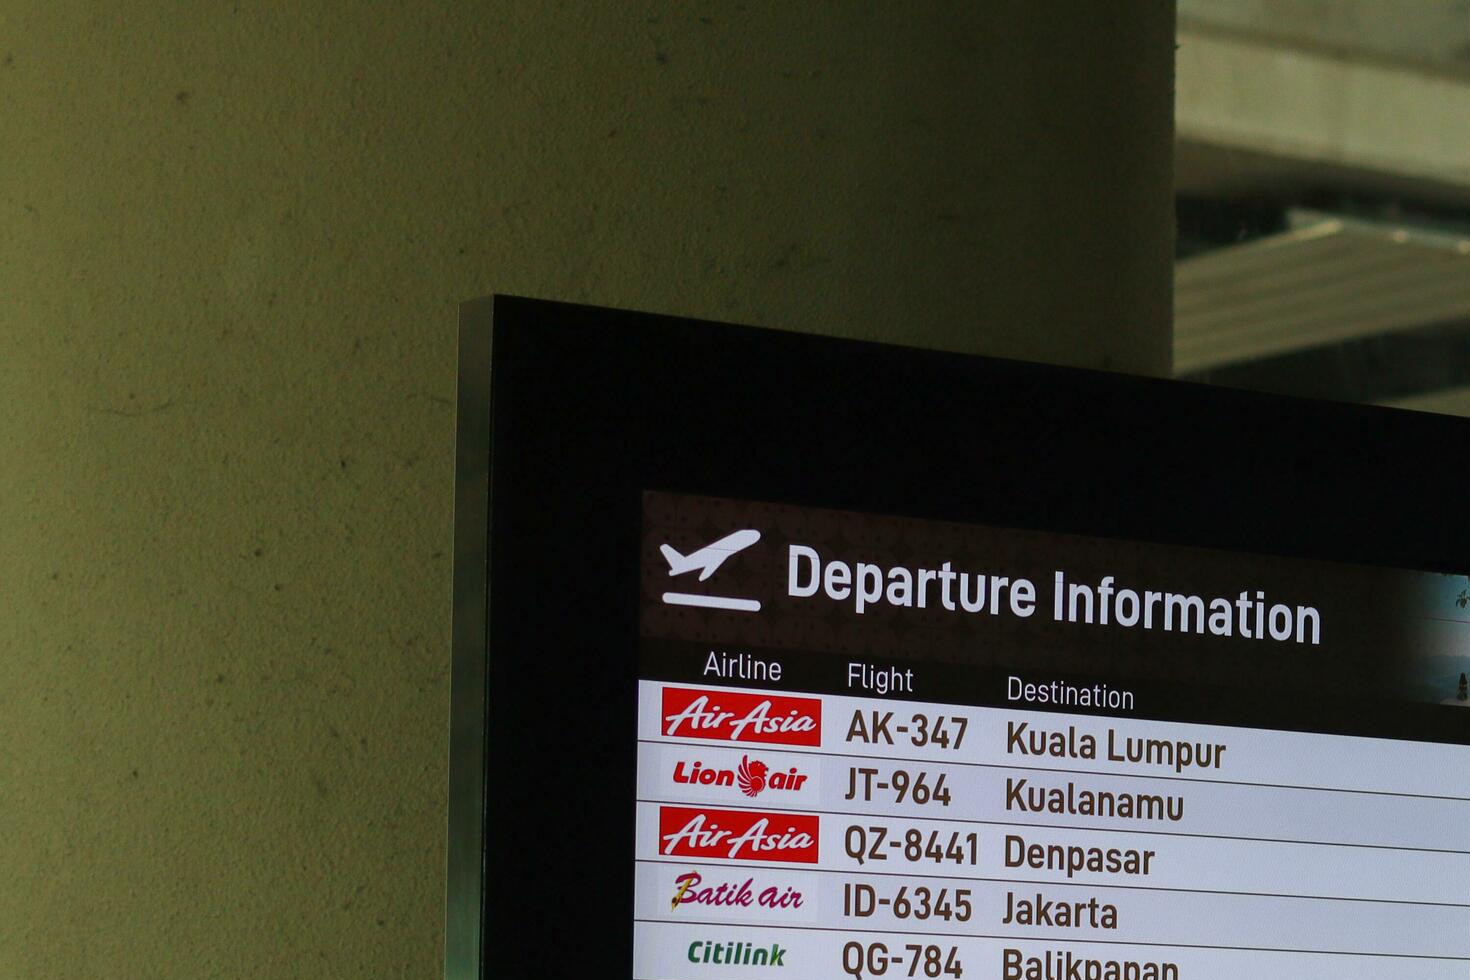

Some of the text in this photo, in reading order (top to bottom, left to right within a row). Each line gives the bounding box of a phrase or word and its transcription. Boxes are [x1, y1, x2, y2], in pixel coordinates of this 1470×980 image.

[788, 544, 1320, 645] Departure Information
[702, 649, 783, 684] Airline
[848, 662, 914, 695] Flight
[1007, 675, 1134, 710] Destination
[845, 709, 968, 750] AK-347
[1007, 721, 1097, 760] Kuala
[1105, 726, 1228, 774] Lumpur
[672, 761, 734, 786] Lion
[768, 767, 807, 791] air
[844, 767, 952, 807] JT-964
[1004, 777, 1186, 823] Kualanamu
[844, 824, 978, 866] QZ-8441
[1003, 836, 1156, 880] Denpasar
[671, 870, 754, 912] Batik
[757, 886, 804, 909] air
[843, 883, 972, 922] ID-6345
[1002, 891, 1118, 930] Jakarta
[687, 940, 787, 967] Citilink
